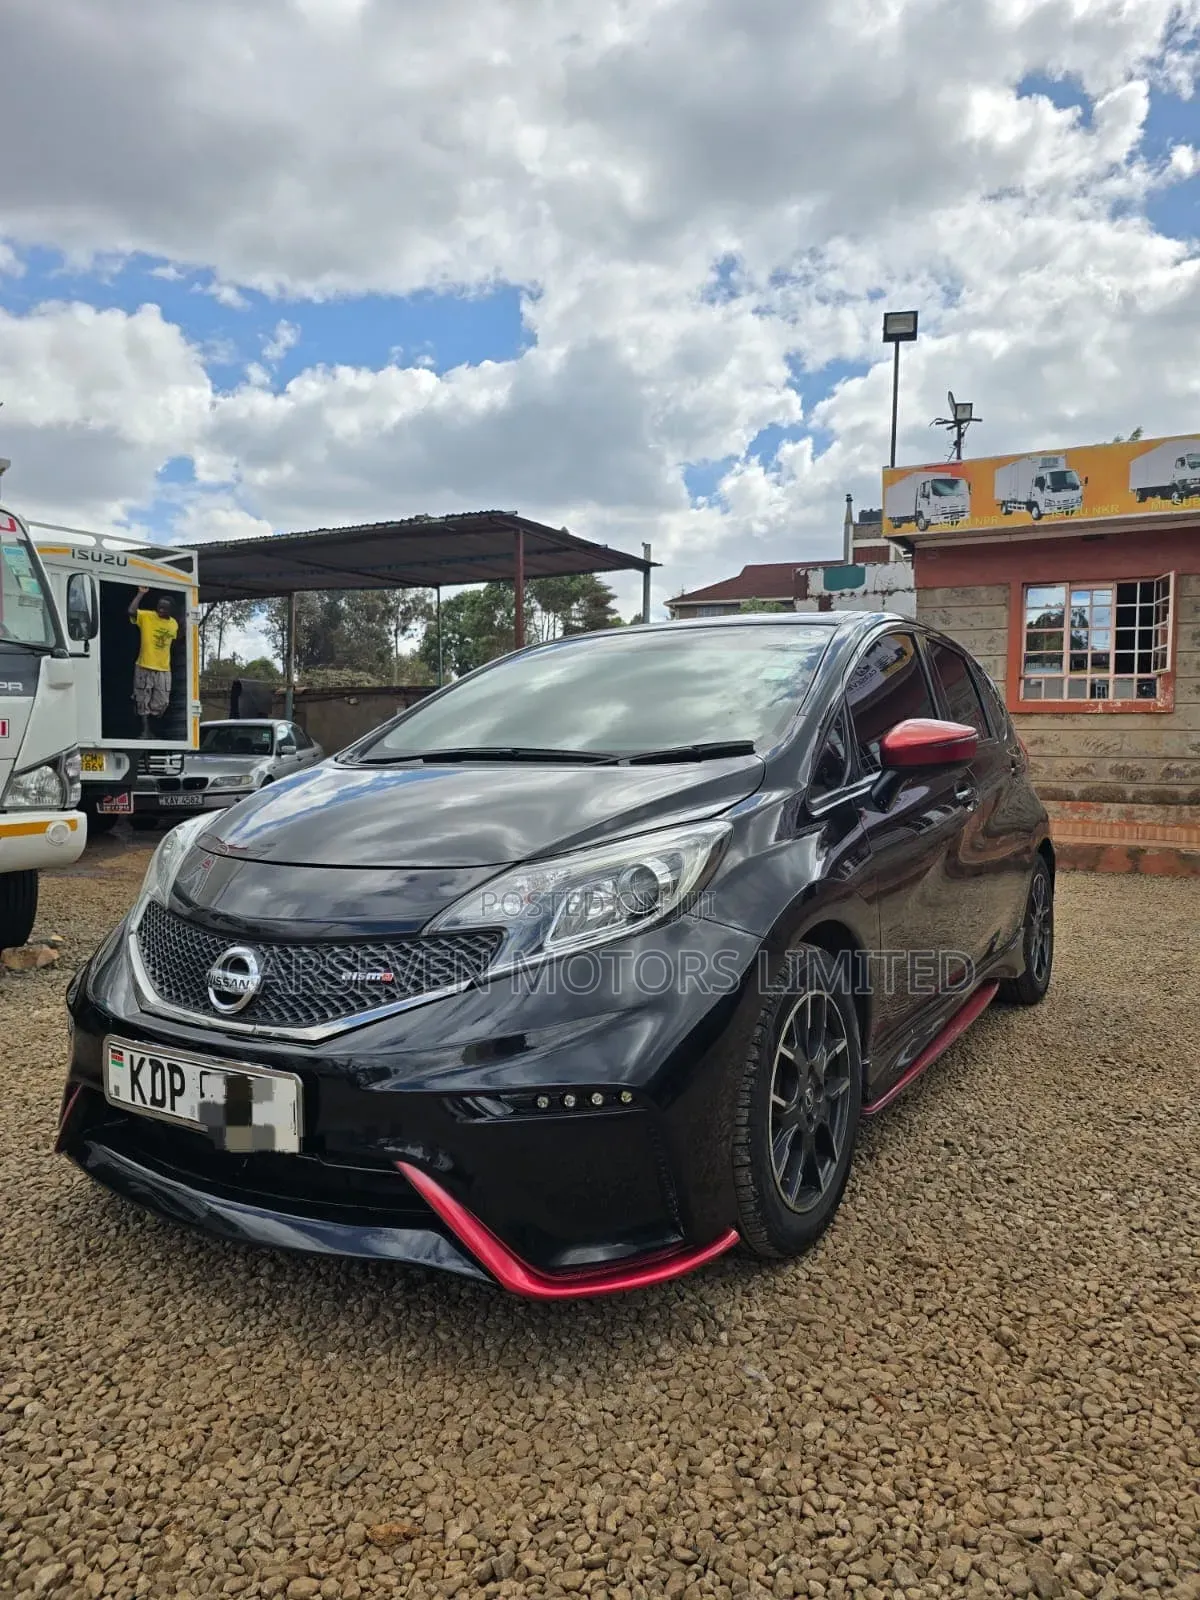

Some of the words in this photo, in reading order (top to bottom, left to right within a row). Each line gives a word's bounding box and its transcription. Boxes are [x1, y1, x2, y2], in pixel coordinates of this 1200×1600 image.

[71, 548, 128, 567] ISUZU
[207, 973, 251, 990] NISSAN
[129, 1053, 186, 1112] KDP
